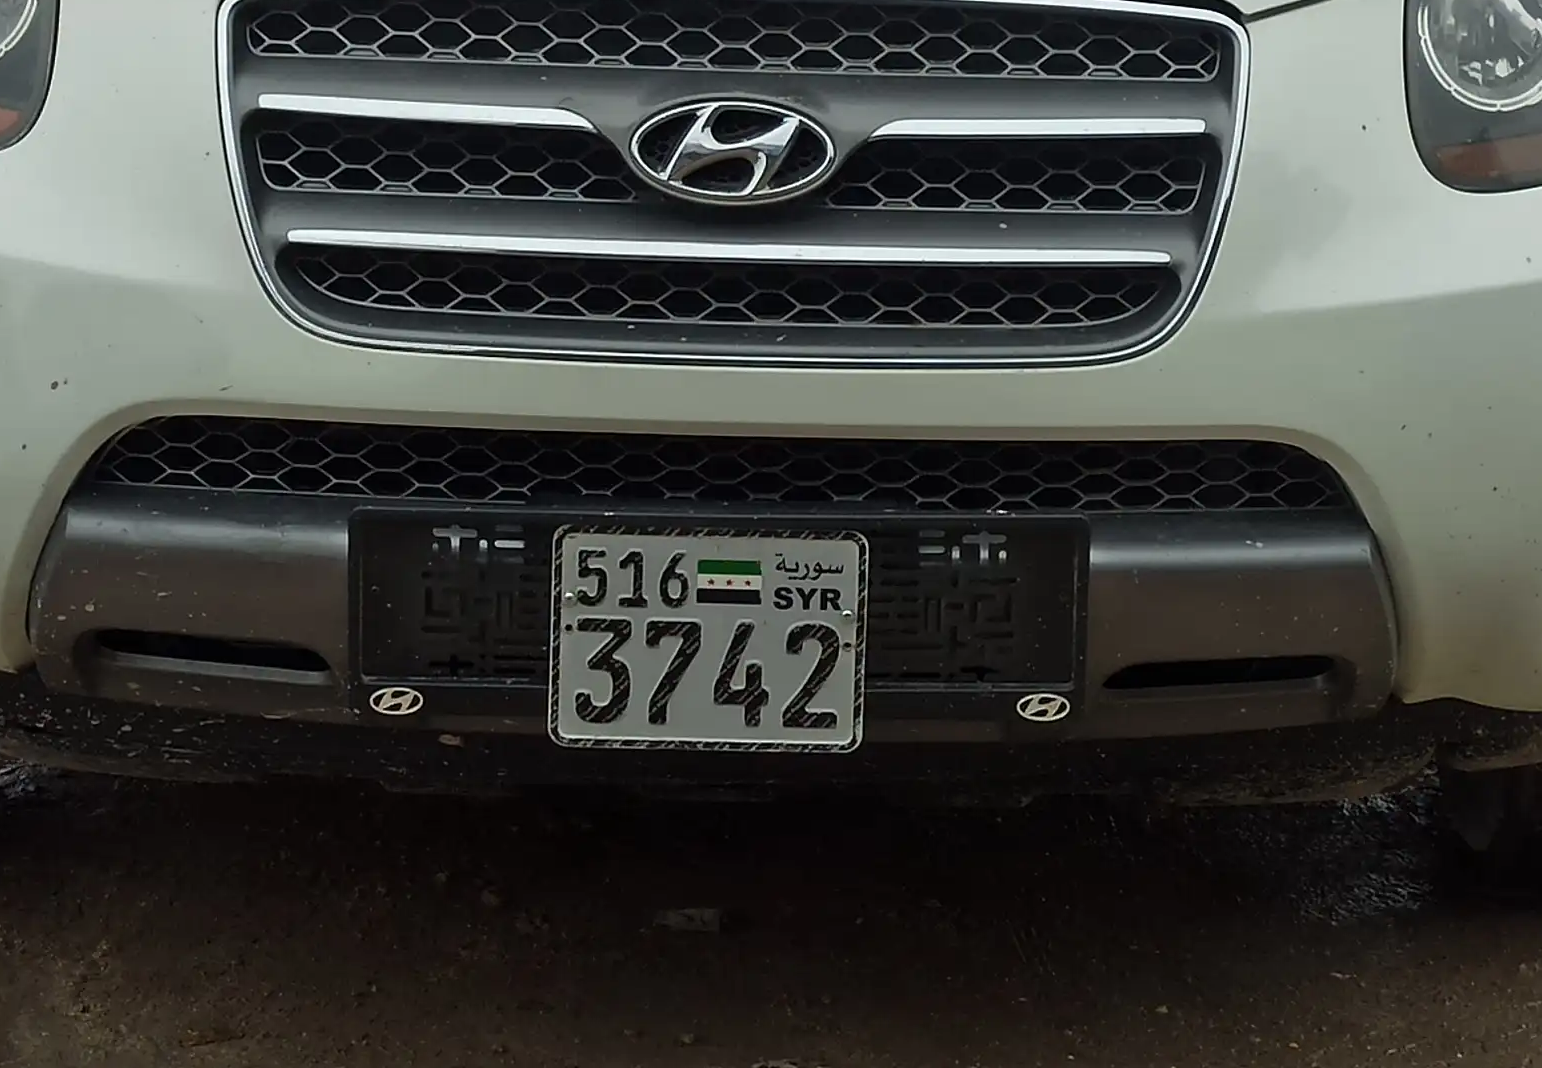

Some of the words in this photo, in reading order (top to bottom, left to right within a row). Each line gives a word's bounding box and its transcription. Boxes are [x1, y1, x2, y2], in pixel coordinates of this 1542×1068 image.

[575, 548, 691, 609] 516
[774, 552, 845, 582] سورية
[772, 587, 843, 611] SYR
[573, 616, 842, 729] 3742
